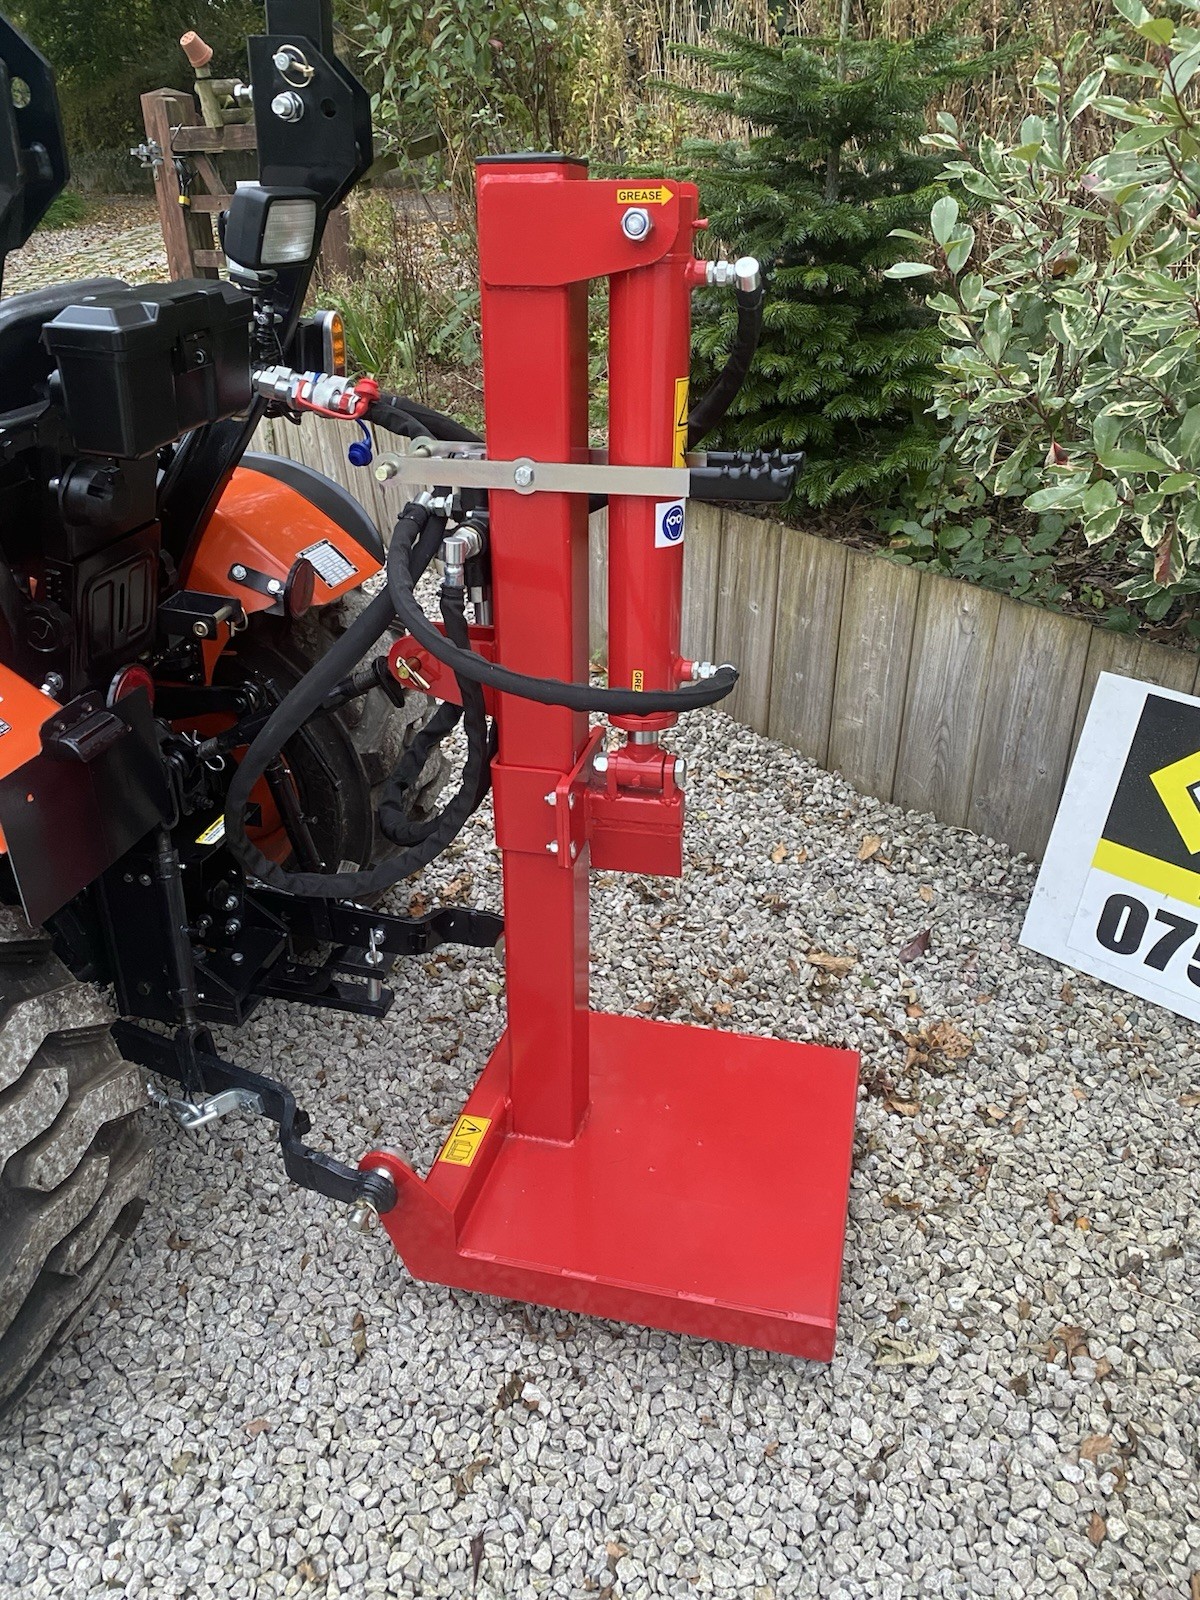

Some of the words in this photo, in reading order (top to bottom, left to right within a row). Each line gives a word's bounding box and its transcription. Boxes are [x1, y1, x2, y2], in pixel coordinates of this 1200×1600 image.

[619, 191, 662, 201] GREASE
[634, 671, 643, 692] GRE
[1096, 893, 1200, 988] 07
